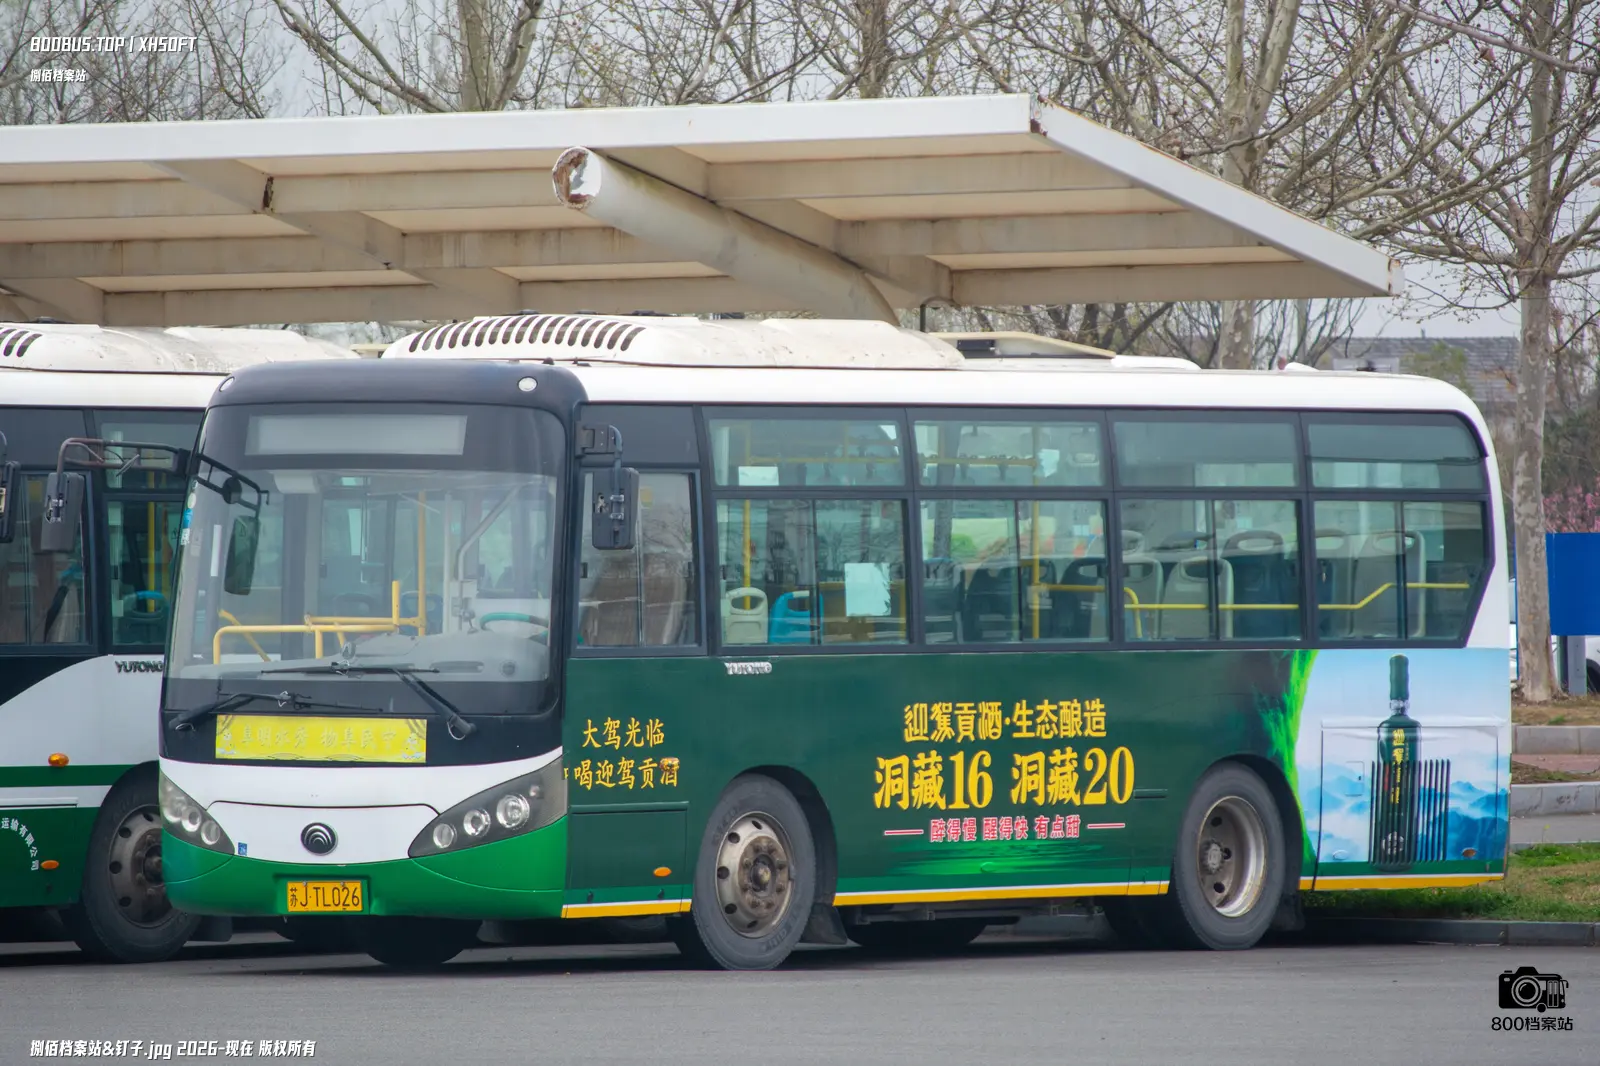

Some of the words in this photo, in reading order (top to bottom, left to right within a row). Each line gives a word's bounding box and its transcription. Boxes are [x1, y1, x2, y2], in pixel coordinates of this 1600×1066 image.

[582, 717, 665, 750] 大驾光临
[874, 750, 993, 810] 洞藏16
[1011, 746, 1135, 806] 洞藏20
[930, 818, 977, 842] 醉得慢
[983, 816, 1028, 840] 醒得快
[1035, 814, 1080, 839] 有点甜
